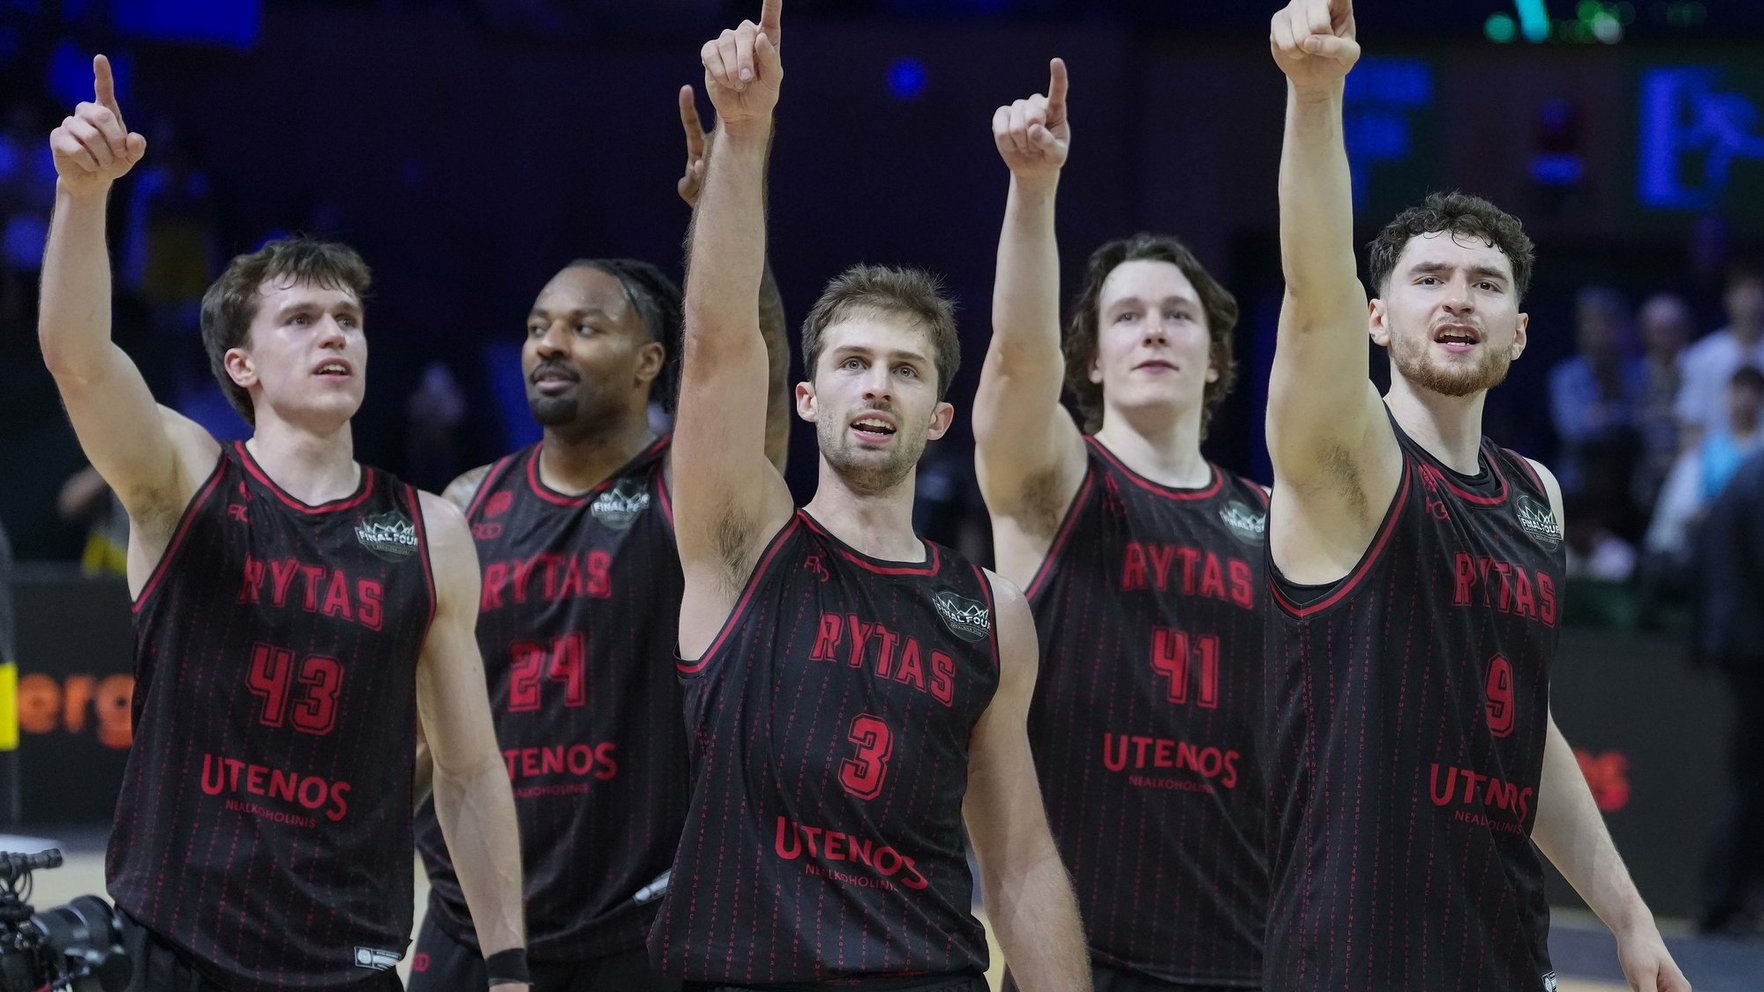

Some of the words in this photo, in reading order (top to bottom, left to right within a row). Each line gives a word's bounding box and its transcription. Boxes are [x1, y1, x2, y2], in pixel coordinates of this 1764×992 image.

[358, 529, 392, 543] FINAL
[236, 551, 384, 633] RYTAS
[479, 548, 612, 614] RYTAS
[1120, 541, 1254, 611] RYTAS
[1452, 551, 1557, 629] RYTAS
[245, 641, 345, 736] 43
[508, 631, 586, 713] 24
[808, 609, 956, 708] RYTAS
[1150, 625, 1220, 709] 41
[1484, 652, 1515, 739] 9
[201, 753, 352, 822] UTENOS
[502, 741, 618, 782] TENOS
[838, 712, 894, 801] 3
[1103, 732, 1240, 789] UTENOS
[775, 815, 929, 890] UTENOS
